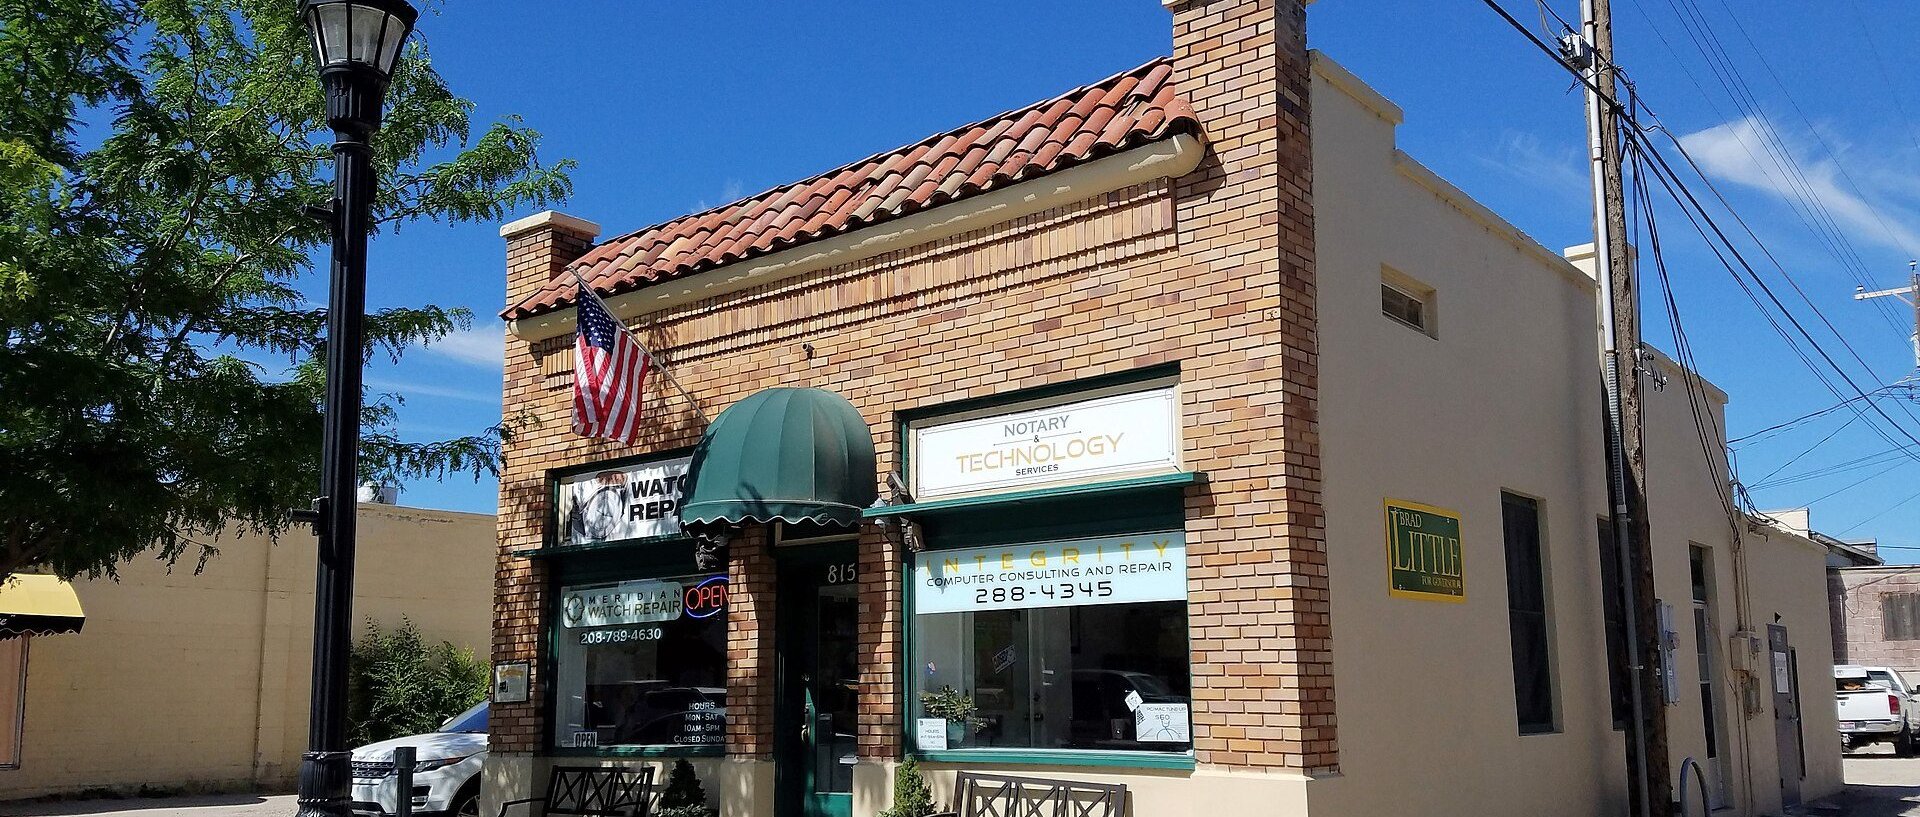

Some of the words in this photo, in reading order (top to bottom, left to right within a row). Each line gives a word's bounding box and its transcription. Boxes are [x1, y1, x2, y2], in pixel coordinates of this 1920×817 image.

[1004, 415, 1070, 437] NOTARY
[1033, 435, 1040, 443] &
[956, 432, 1125, 473] TECHNOLOGY
[1015, 464, 1059, 476] SERVICES
[631, 474, 687, 498] WATC
[1400, 512, 1422, 527] BRAD
[1391, 510, 1460, 577] LITTLE
[926, 540, 1170, 575] INTEGRITY
[828, 562, 856, 583] 815
[926, 573, 995, 587] COMPUTER
[999, 567, 1080, 582] CONSULTING
[1085, 564, 1114, 577] AND
[1119, 561, 1172, 574] REPAIR
[588, 590, 681, 604] MERIDIAN
[685, 584, 731, 610] OPEN
[976, 581, 1113, 604] 288-4345
[588, 603, 631, 619] WATCH
[634, 600, 681, 616] REPAIR
[688, 701, 715, 710] HOURS
[575, 732, 597, 747] OPEN
[673, 735, 700, 743] CLOSED
